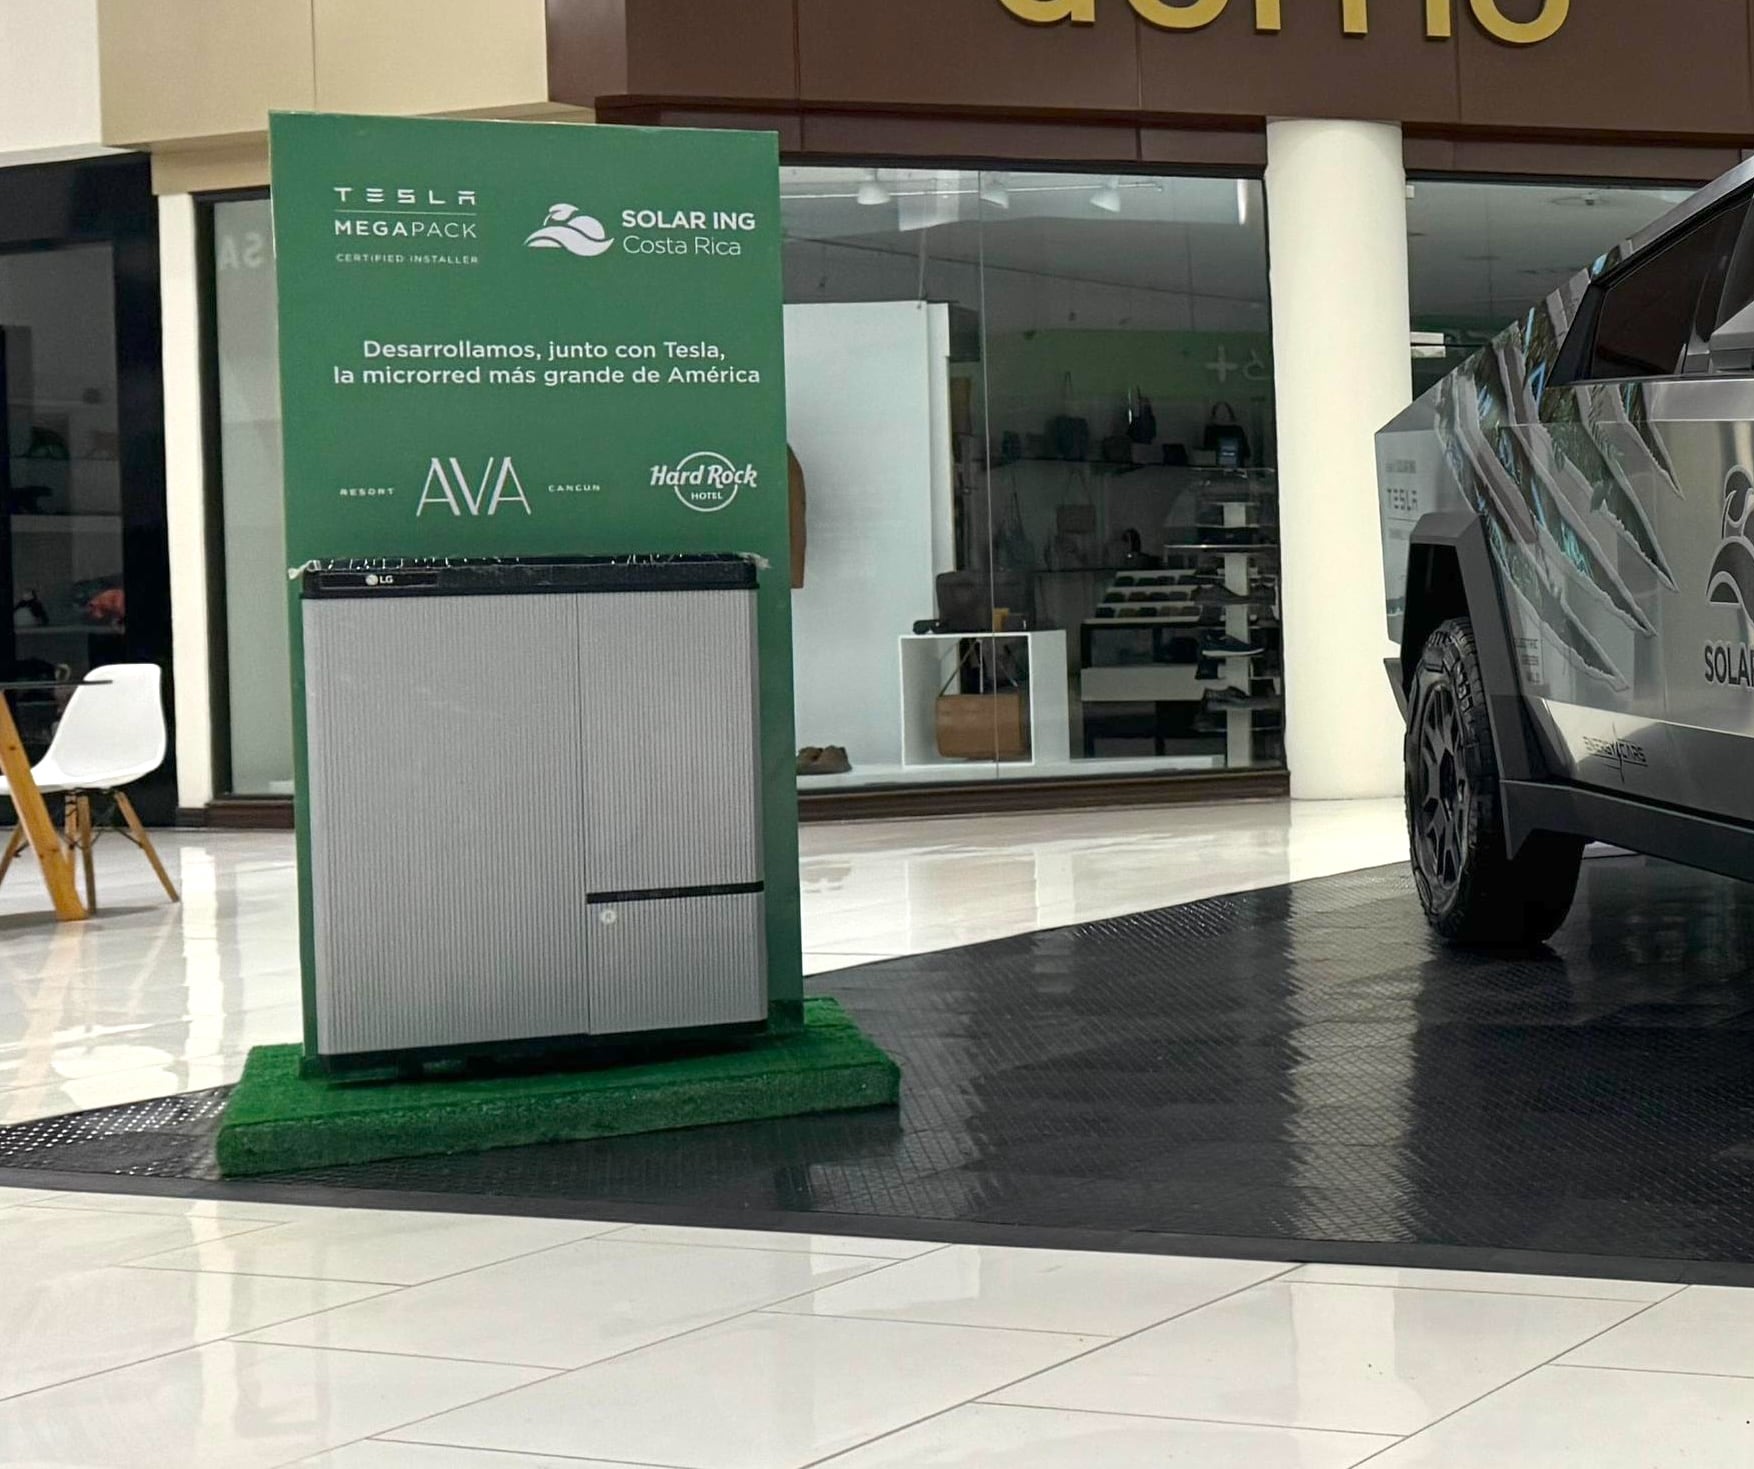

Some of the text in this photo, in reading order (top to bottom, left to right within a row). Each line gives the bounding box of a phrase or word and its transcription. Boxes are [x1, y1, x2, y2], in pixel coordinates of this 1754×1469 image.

[333, 187, 476, 205] TESLA
[334, 219, 477, 239] MEGAPACK
[622, 209, 756, 231] SOLAR ING
[623, 235, 741, 256] Costa Rica
[335, 253, 479, 264] CERTIFIED INSTALLER
[363, 340, 726, 361] Desarrollamos, junto con Tesla,
[334, 366, 760, 386] la microrred más grande de América
[650, 463, 758, 489] Hard Rock
[339, 456, 600, 517] RESORT AVA CANCUN
[691, 491, 723, 501] HOTEL
[380, 575, 393, 584] LG
